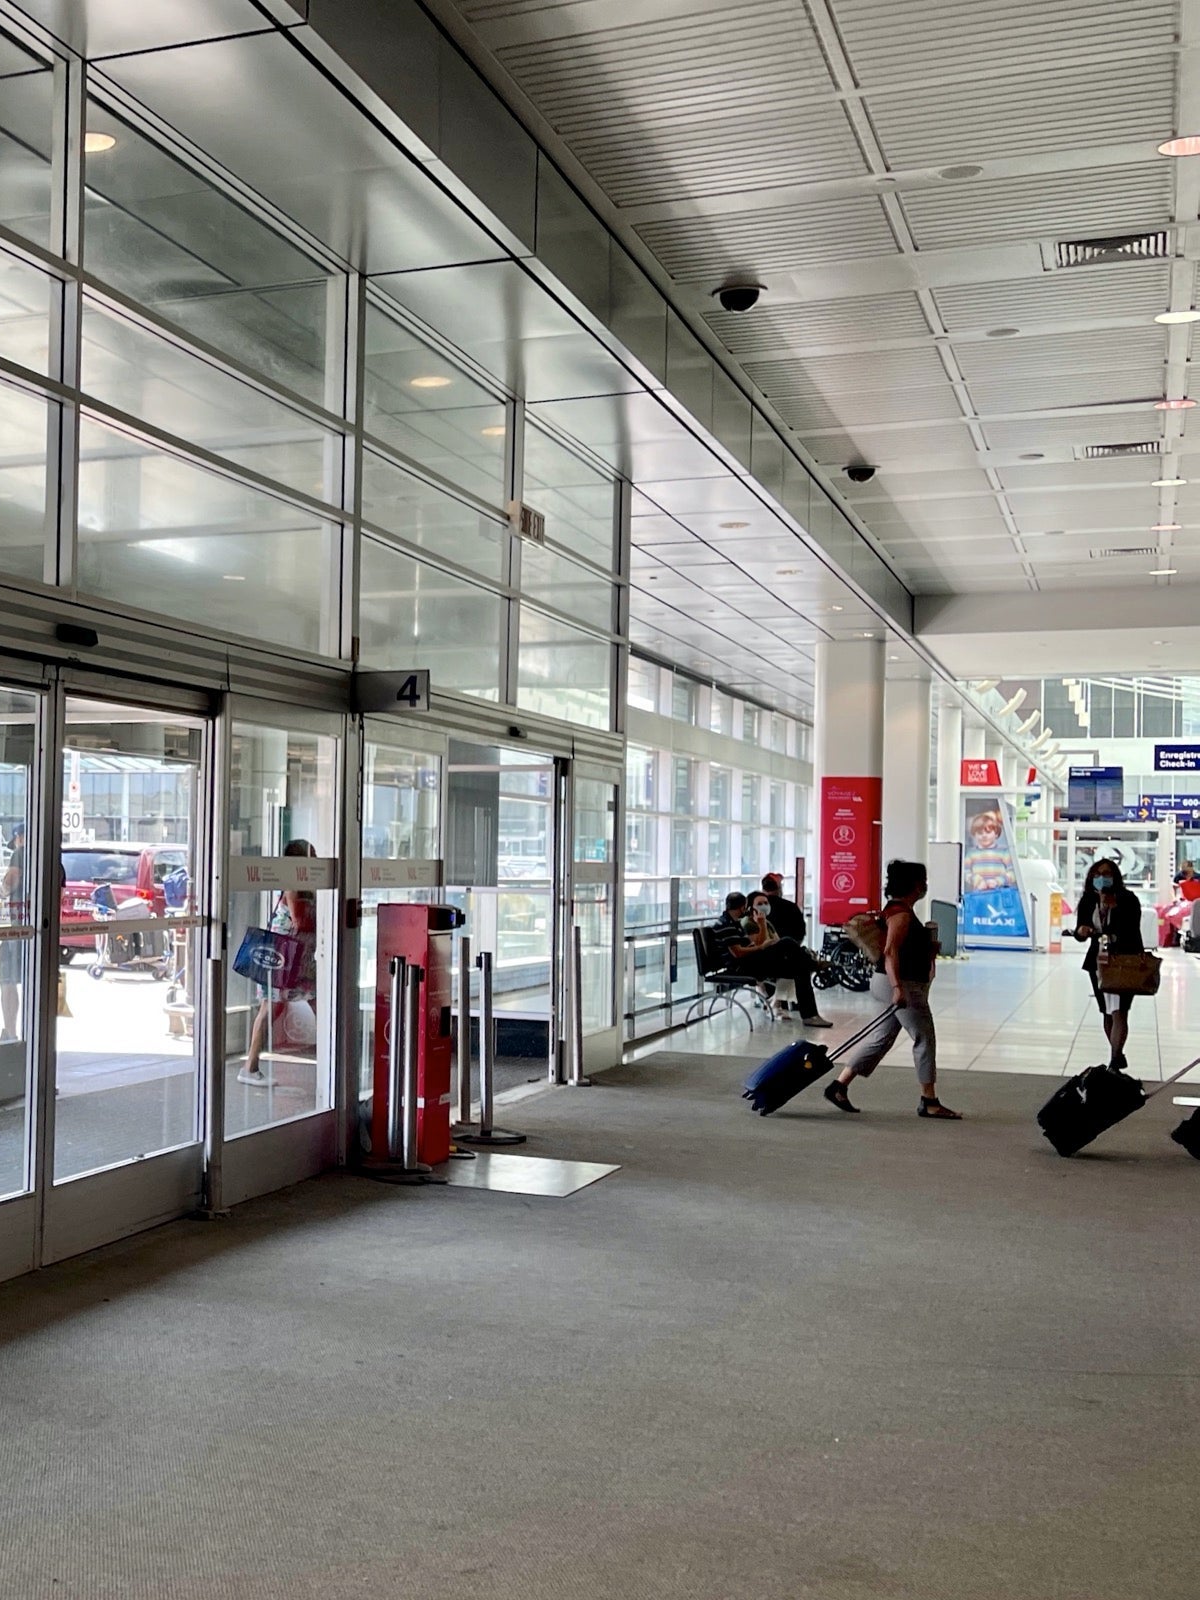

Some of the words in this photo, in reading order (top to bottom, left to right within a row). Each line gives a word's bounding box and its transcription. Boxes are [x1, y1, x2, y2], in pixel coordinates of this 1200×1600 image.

[396, 675, 420, 707] 4
[1160, 760, 1196, 768] Check-in
[63, 812, 80, 828] 30
[1167, 816, 1174, 824] 5
